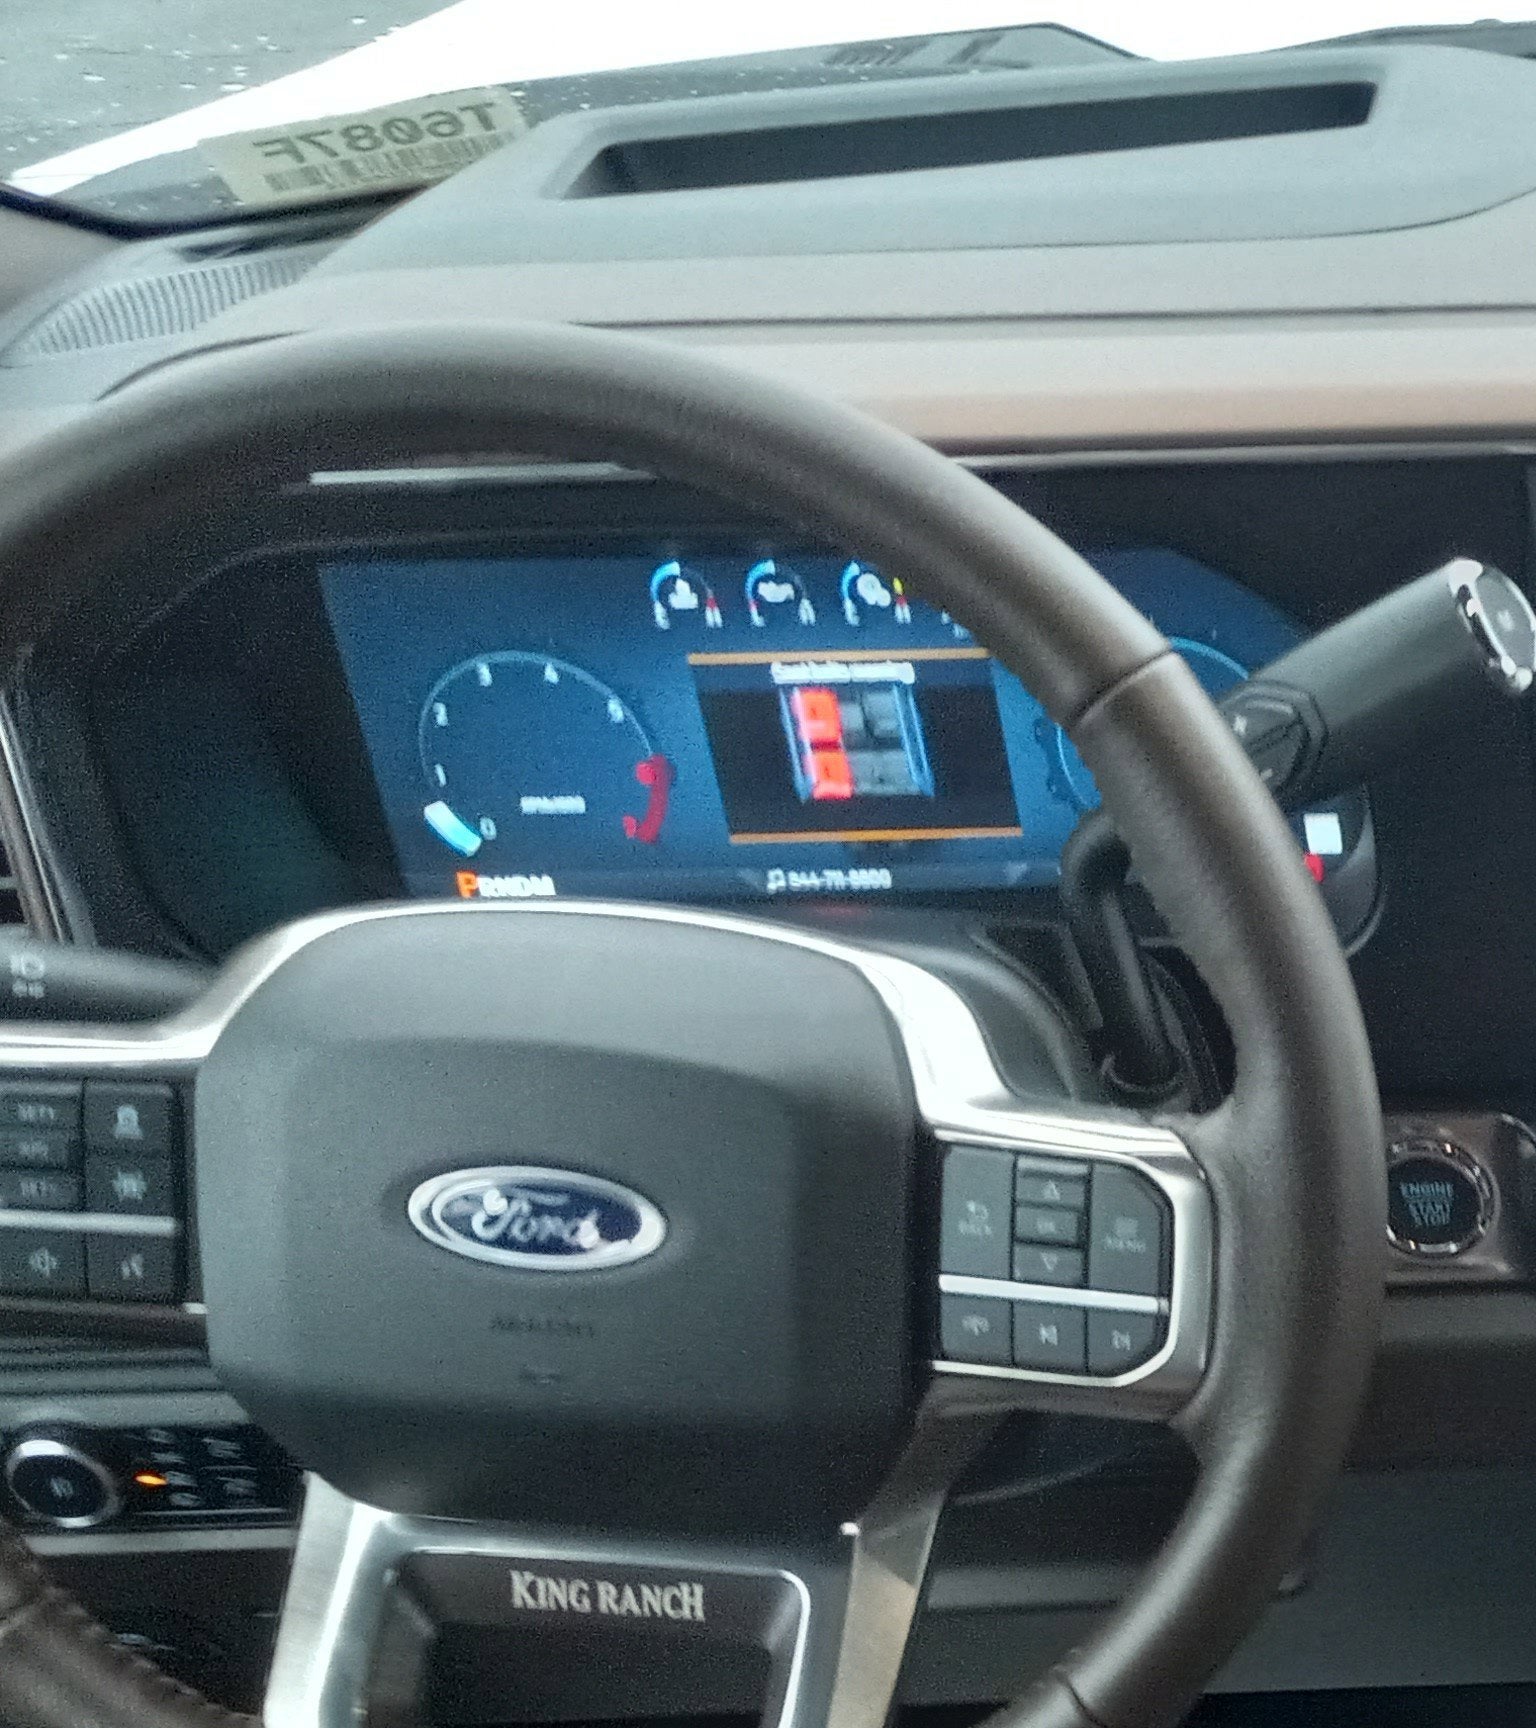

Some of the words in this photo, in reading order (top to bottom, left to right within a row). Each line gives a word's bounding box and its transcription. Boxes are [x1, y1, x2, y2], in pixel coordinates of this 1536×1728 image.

[1400, 1181, 1454, 1198] ENGINE
[1408, 1200, 1450, 1214] START
[471, 1184, 606, 1250] Ford
[509, 1569, 591, 1613] KING
[595, 1579, 705, 1623] RANCH
